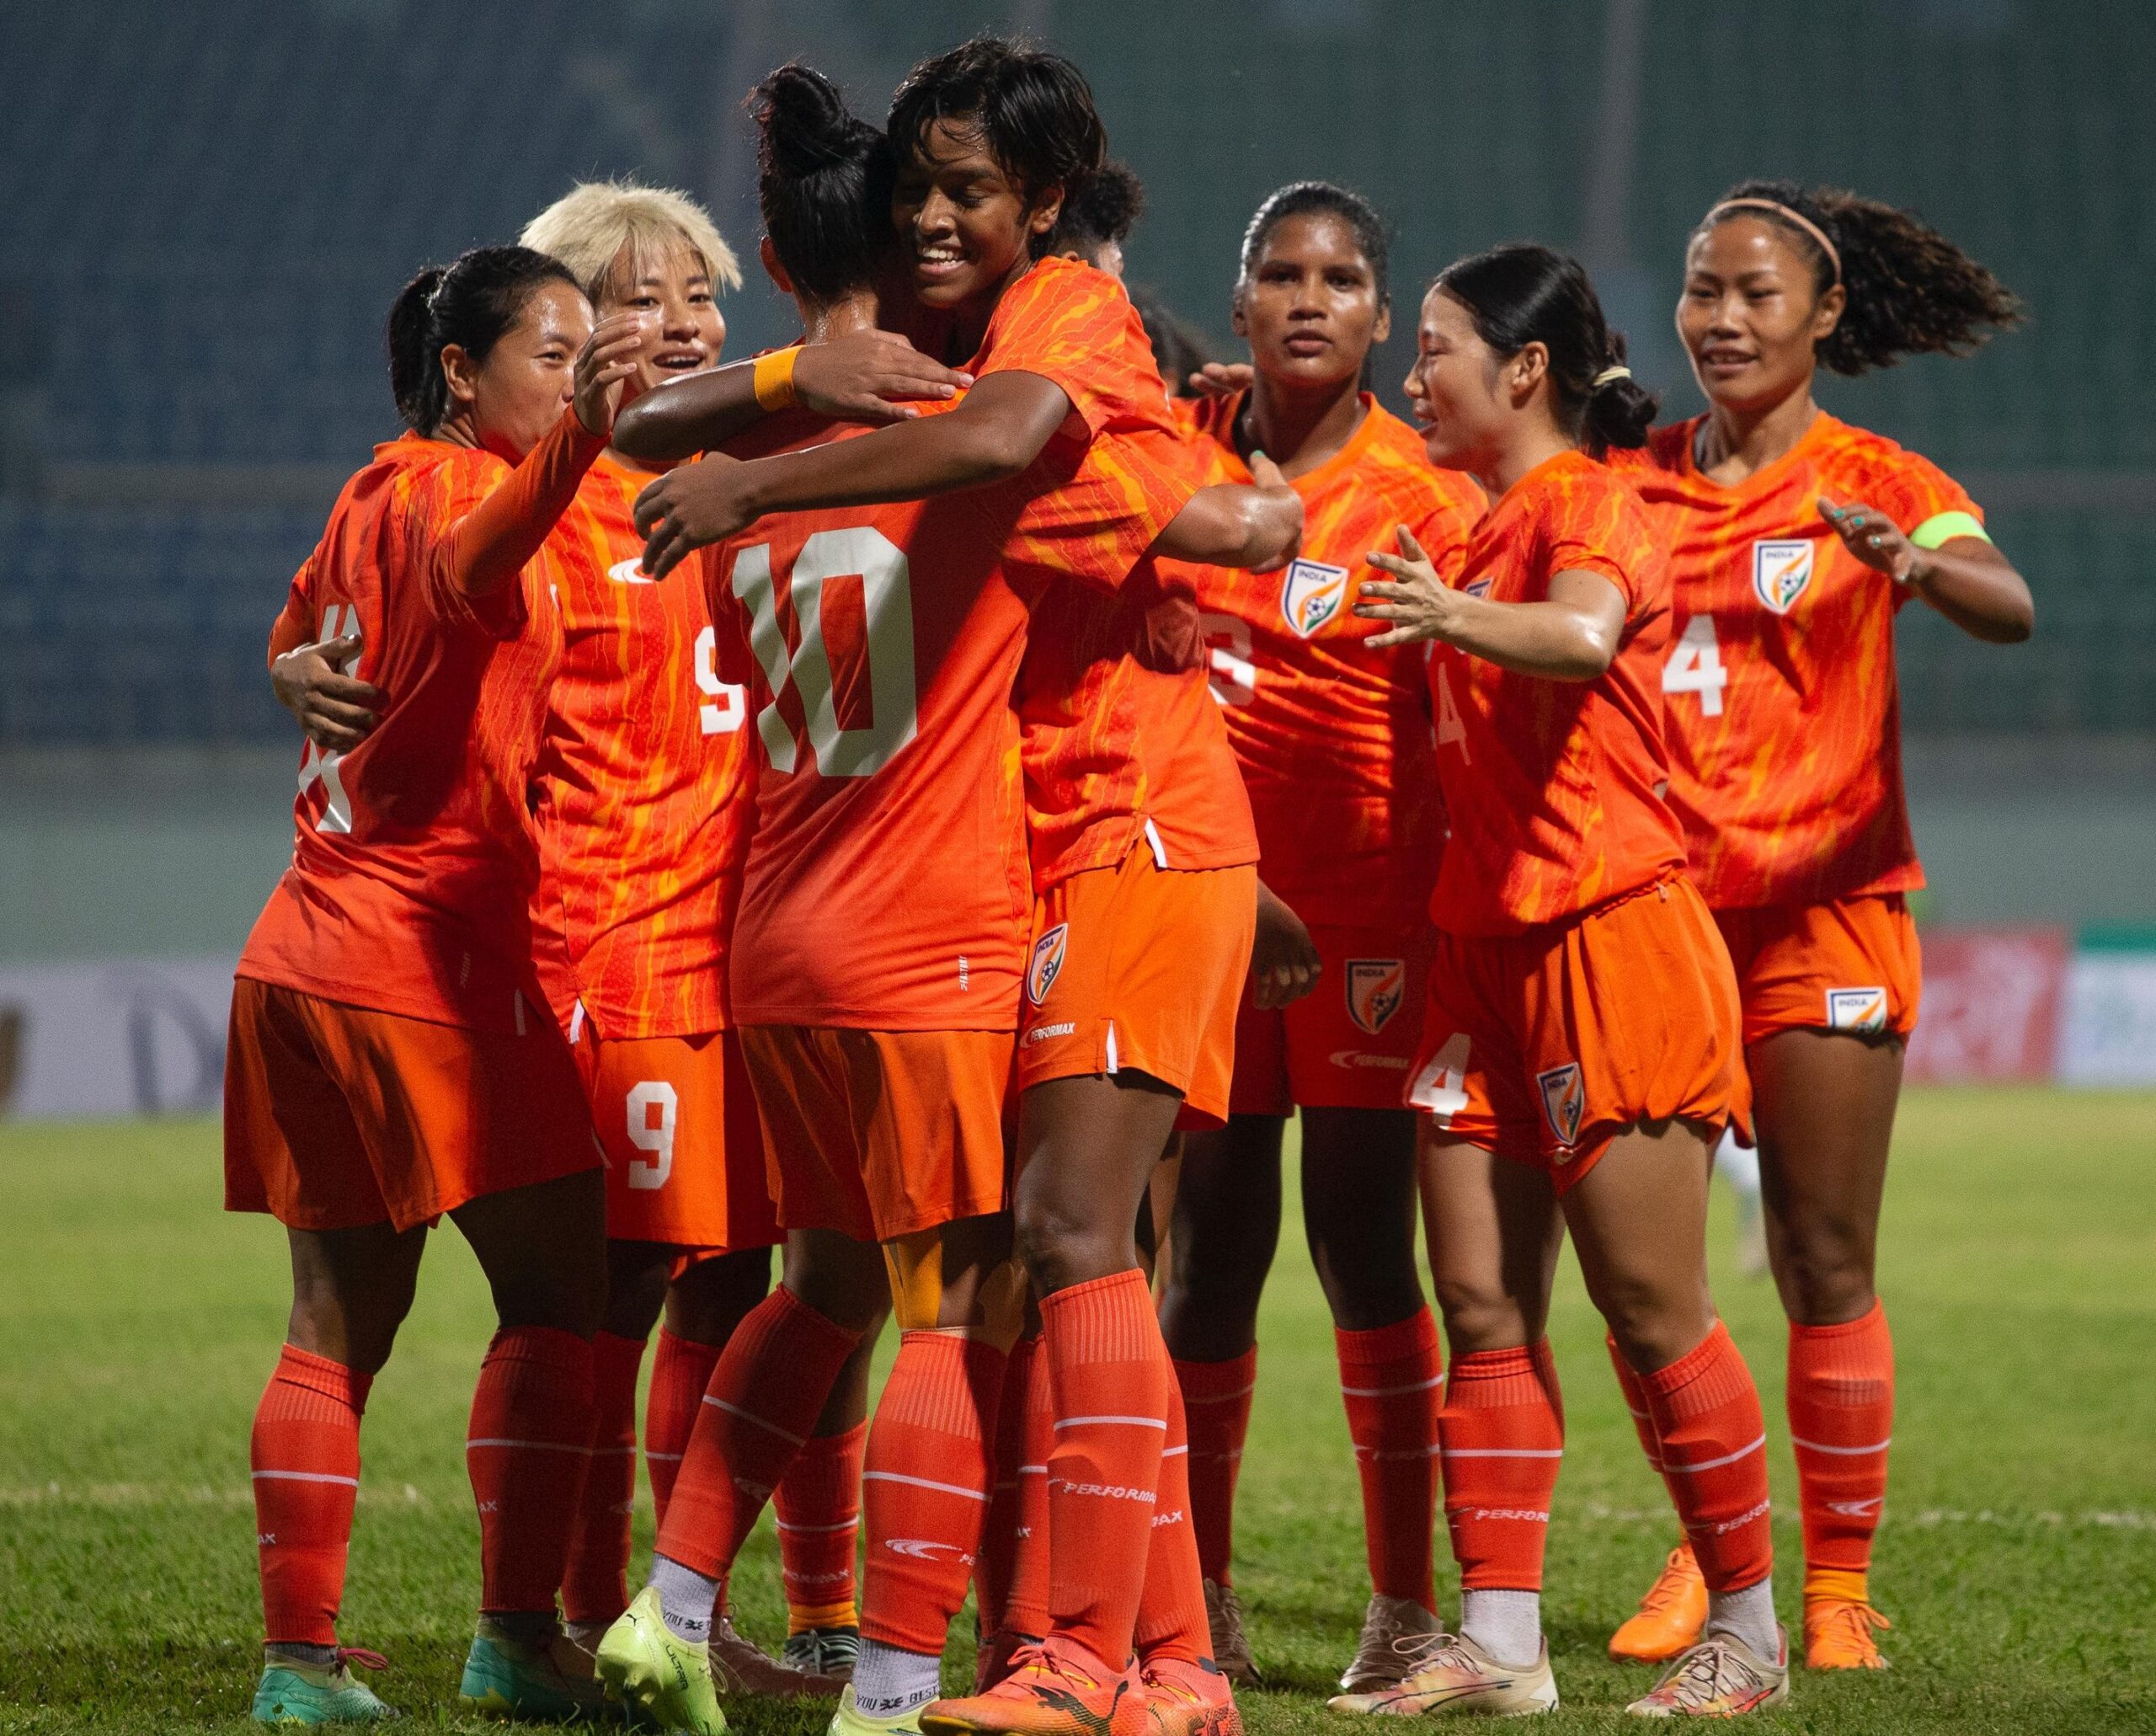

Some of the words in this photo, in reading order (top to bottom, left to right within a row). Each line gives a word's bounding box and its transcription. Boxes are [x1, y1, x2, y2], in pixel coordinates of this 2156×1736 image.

[732, 526, 918, 777] 10
[1661, 613, 1728, 718] 4
[1037, 937, 1054, 953] INDIA
[1030, 1022, 1075, 1043] PERFORMAX
[1409, 1032, 1472, 1131] 4
[626, 1080, 679, 1190] 9
[665, 1643, 689, 1691] ULTRA
[856, 1694, 878, 1711] YOU
